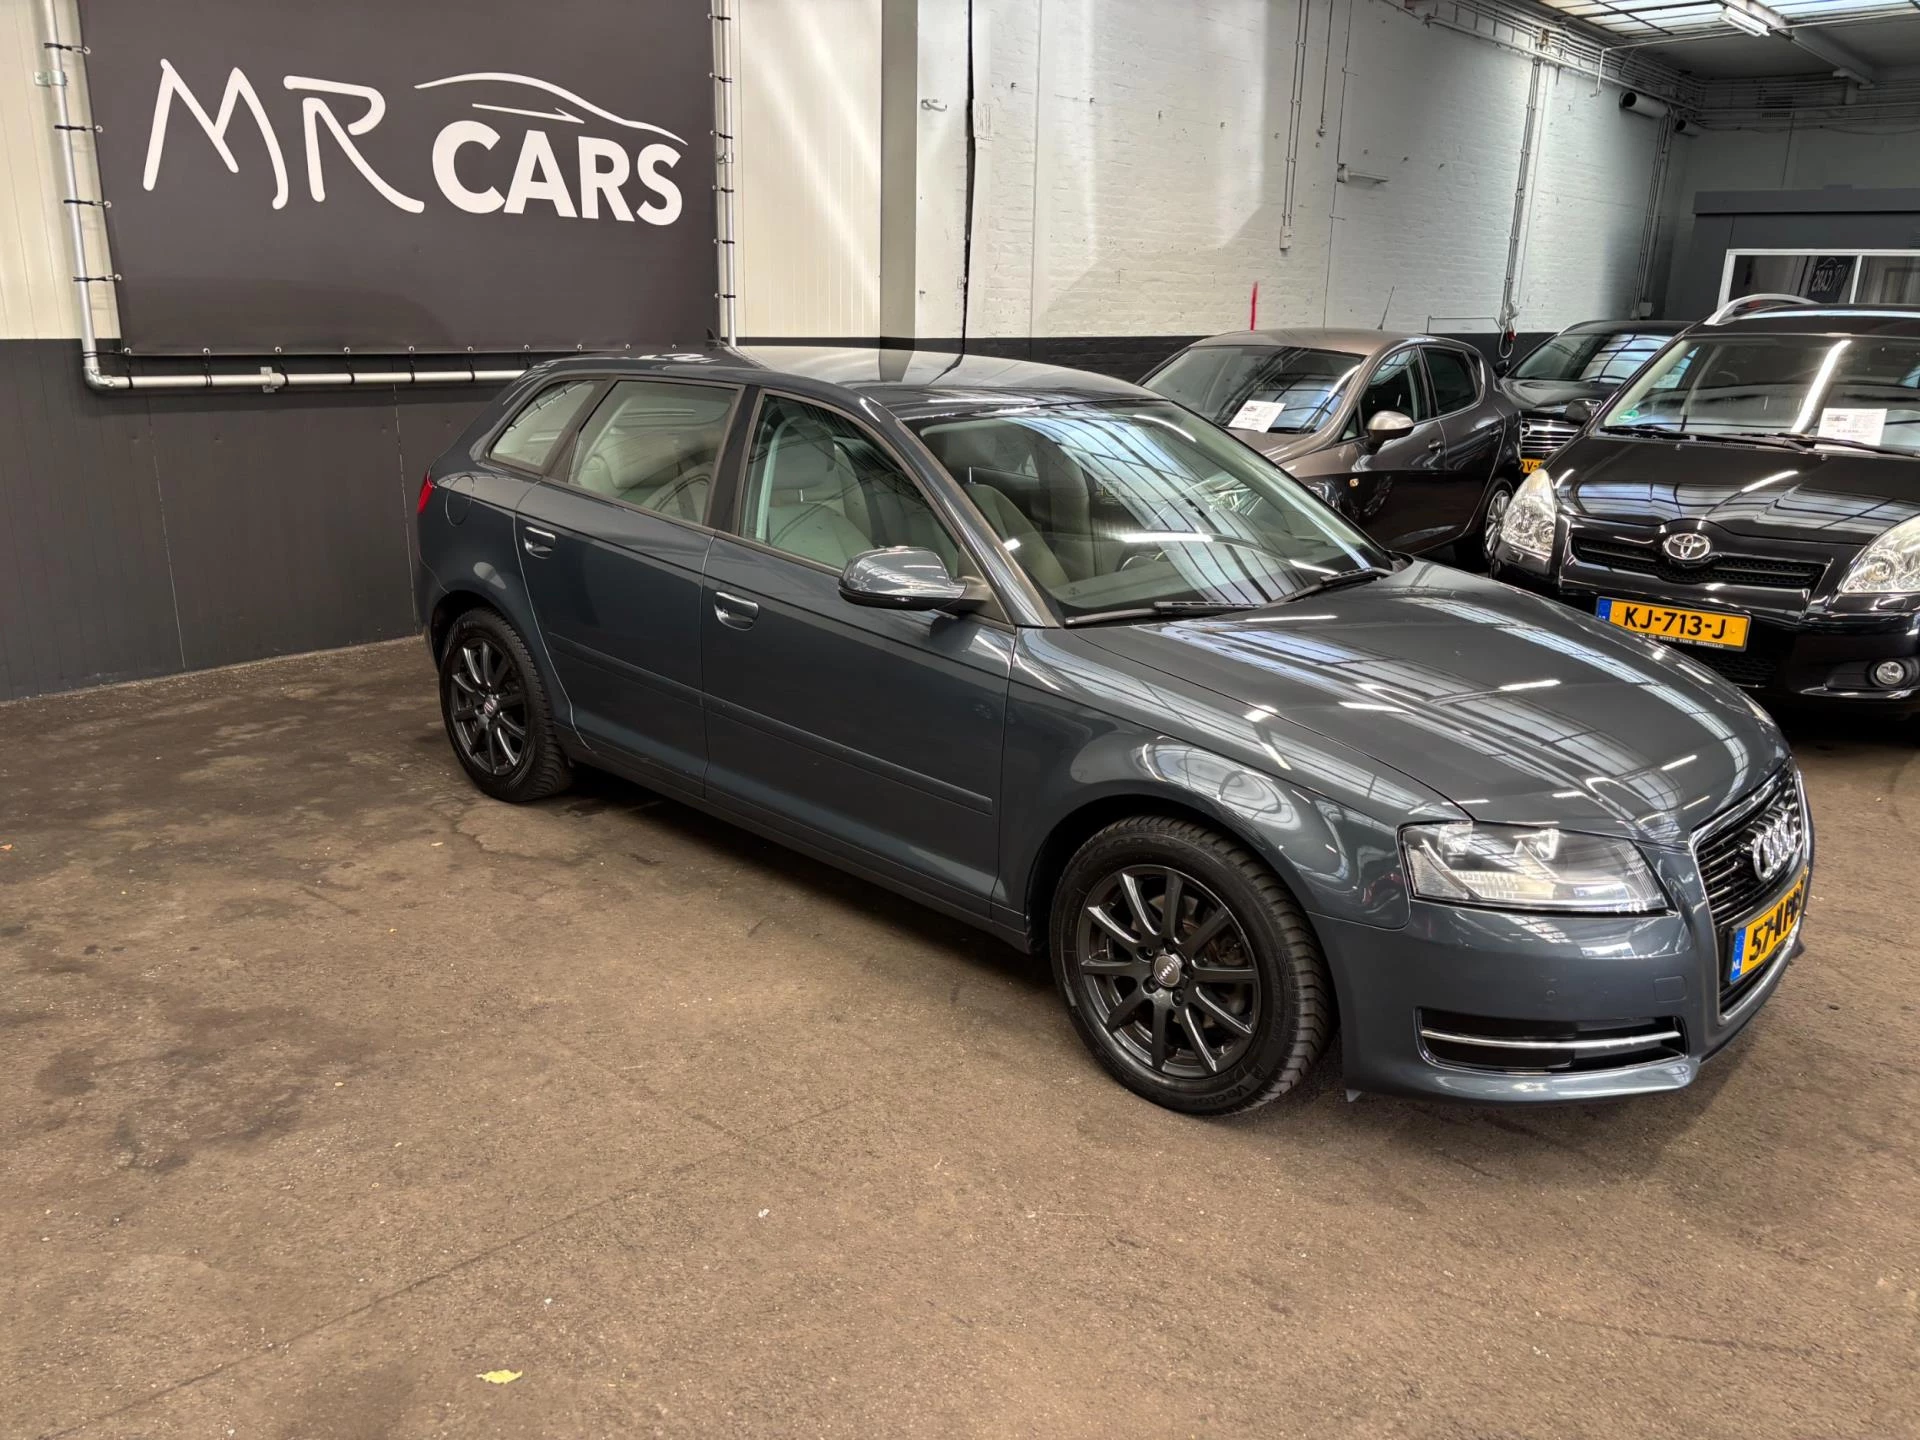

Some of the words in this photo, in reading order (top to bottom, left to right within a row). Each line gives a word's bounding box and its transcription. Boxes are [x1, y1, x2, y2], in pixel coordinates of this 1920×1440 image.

[143, 58, 425, 212] MR
[431, 119, 683, 226] CARS
[1623, 606, 1726, 639] KJ-713-J
